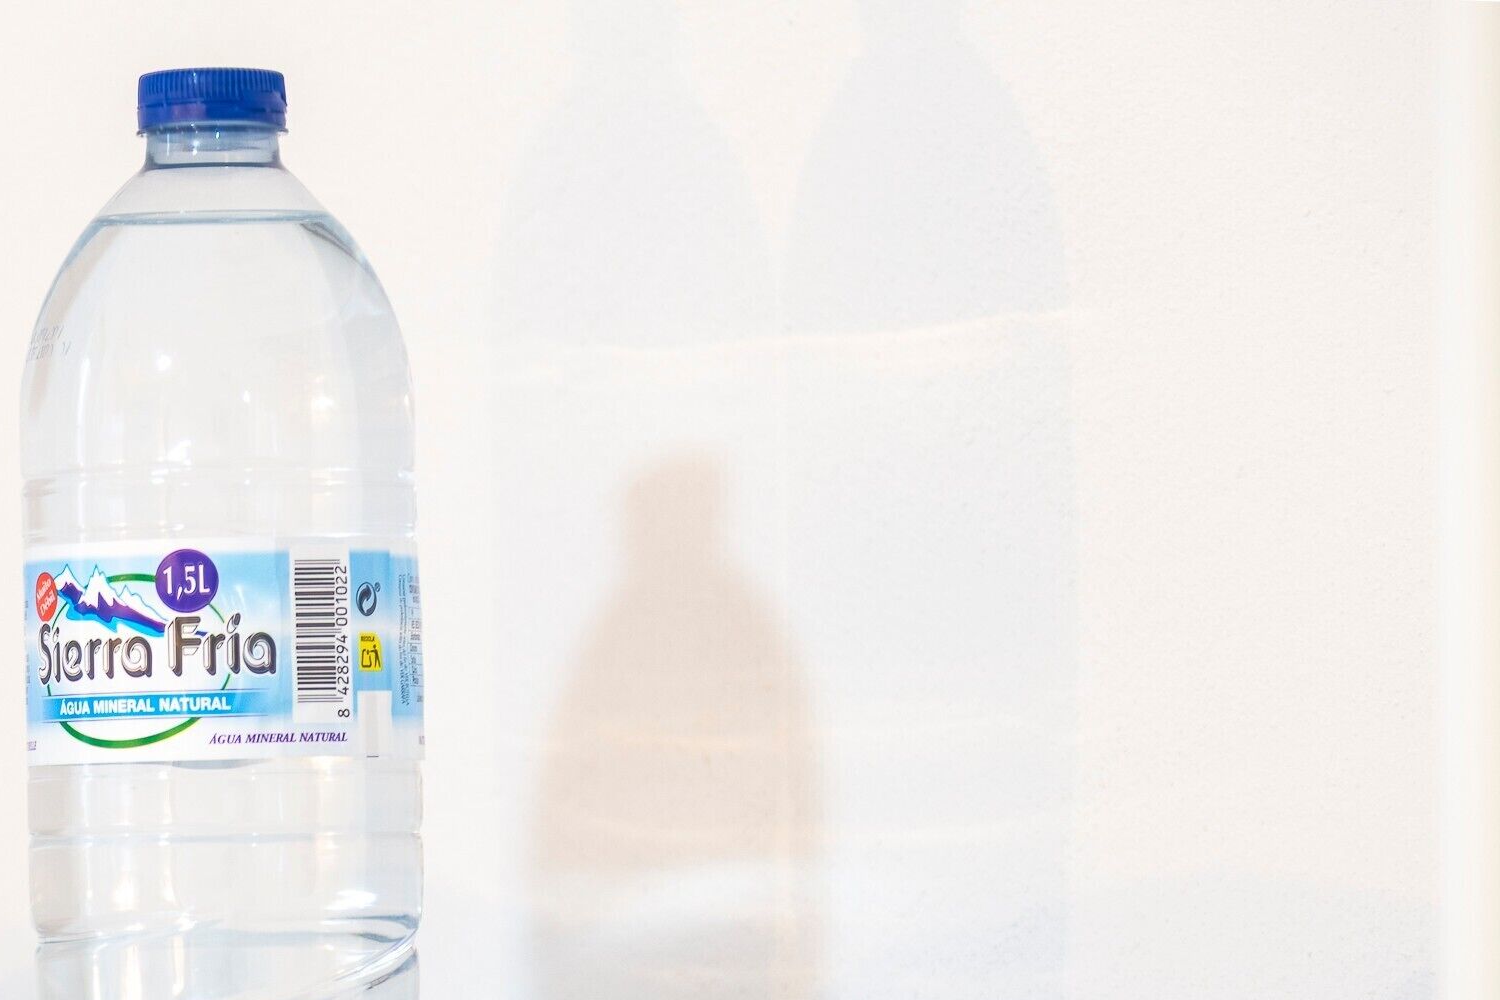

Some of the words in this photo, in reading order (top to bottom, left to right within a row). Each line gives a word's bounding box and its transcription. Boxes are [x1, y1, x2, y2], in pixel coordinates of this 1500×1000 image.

[163, 562, 211, 601] 1,5L
[334, 565, 348, 627] 001022
[38, 623, 153, 686] Sierra
[336, 634, 349, 695] 428294
[59, 698, 91, 716] ÁGUA
[93, 697, 155, 714] MINERAL
[158, 694, 232, 712] NATURAL
[337, 708, 350, 718] 8
[208, 732, 242, 745] ÁGUA
[245, 732, 296, 744] MINERAL
[299, 731, 348, 743] NATURAL
